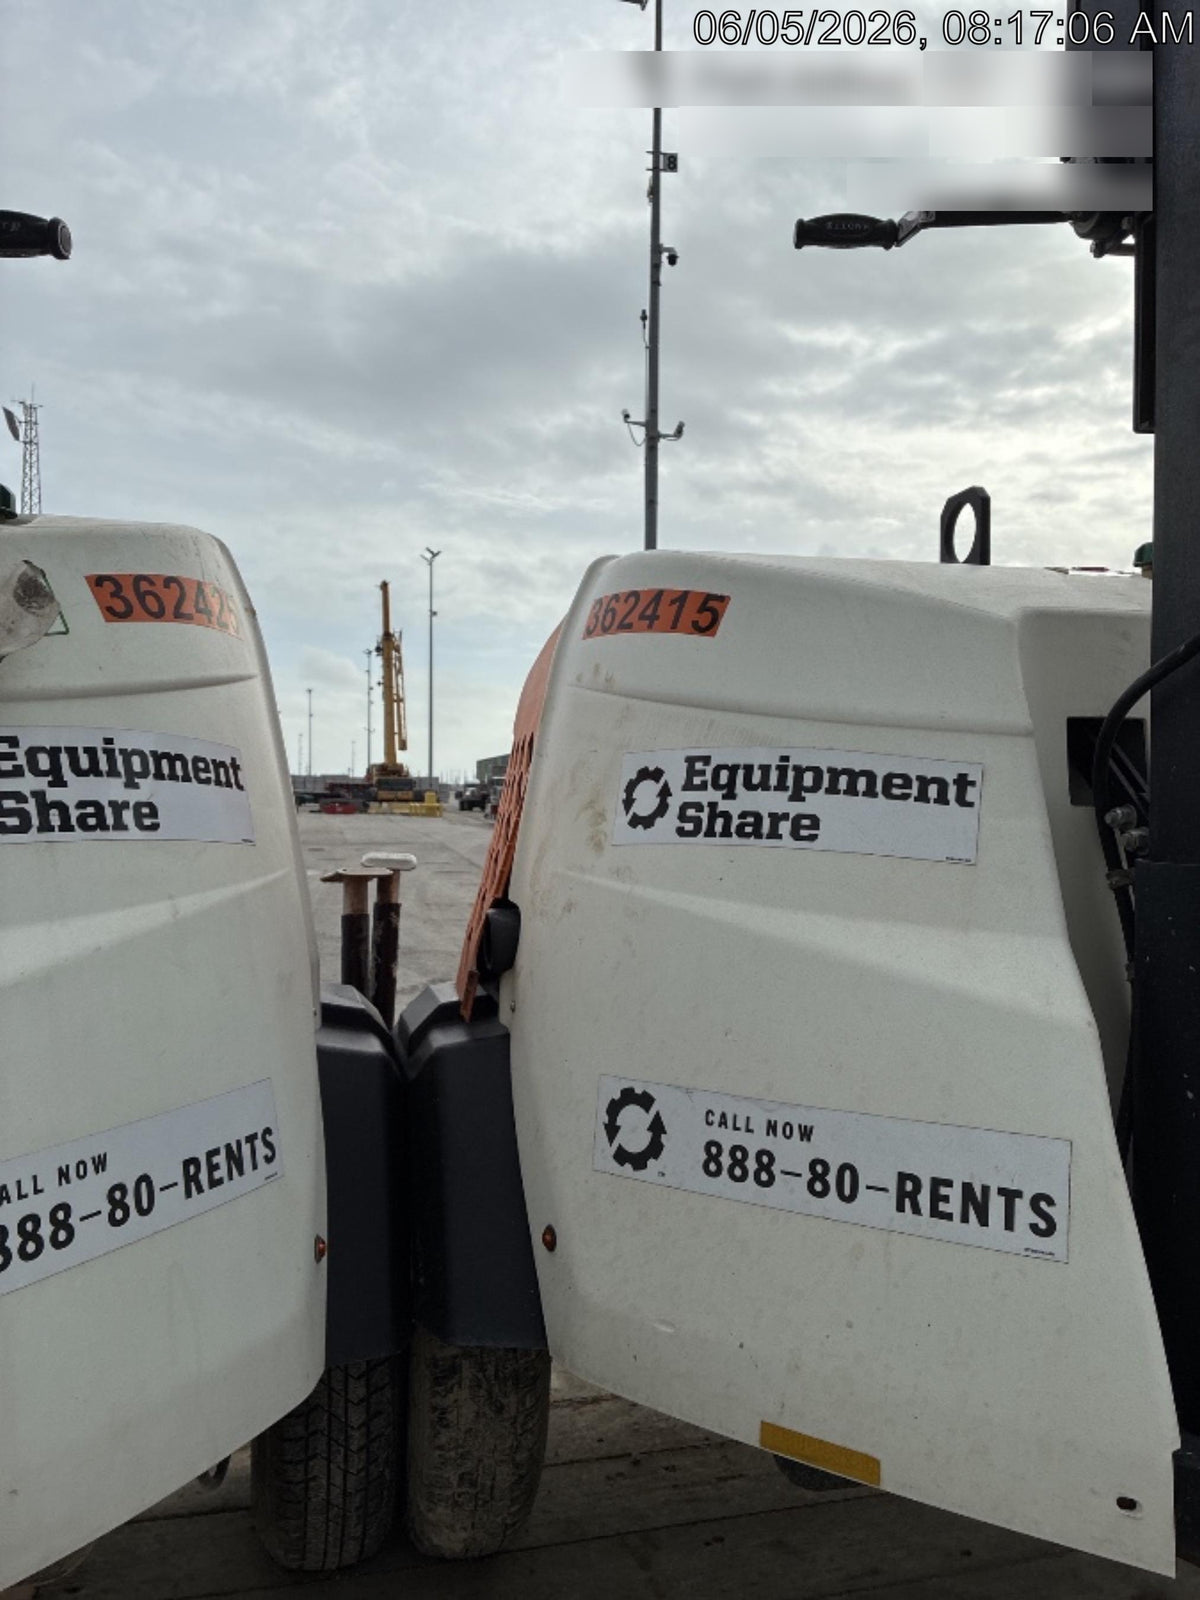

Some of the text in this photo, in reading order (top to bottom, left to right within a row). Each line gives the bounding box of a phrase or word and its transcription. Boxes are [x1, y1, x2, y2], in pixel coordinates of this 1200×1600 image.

[667, 155, 677, 171] 8
[585, 589, 728, 637] 362415
[0, 735, 246, 792] Equipment
[681, 755, 977, 808] Equipment
[0, 788, 161, 835] Share
[675, 801, 821, 842] Share
[704, 1109, 815, 1143] CALL NOW
[57, 1152, 108, 1187] NOW
[701, 1139, 1058, 1239] 888-80-RENTS
